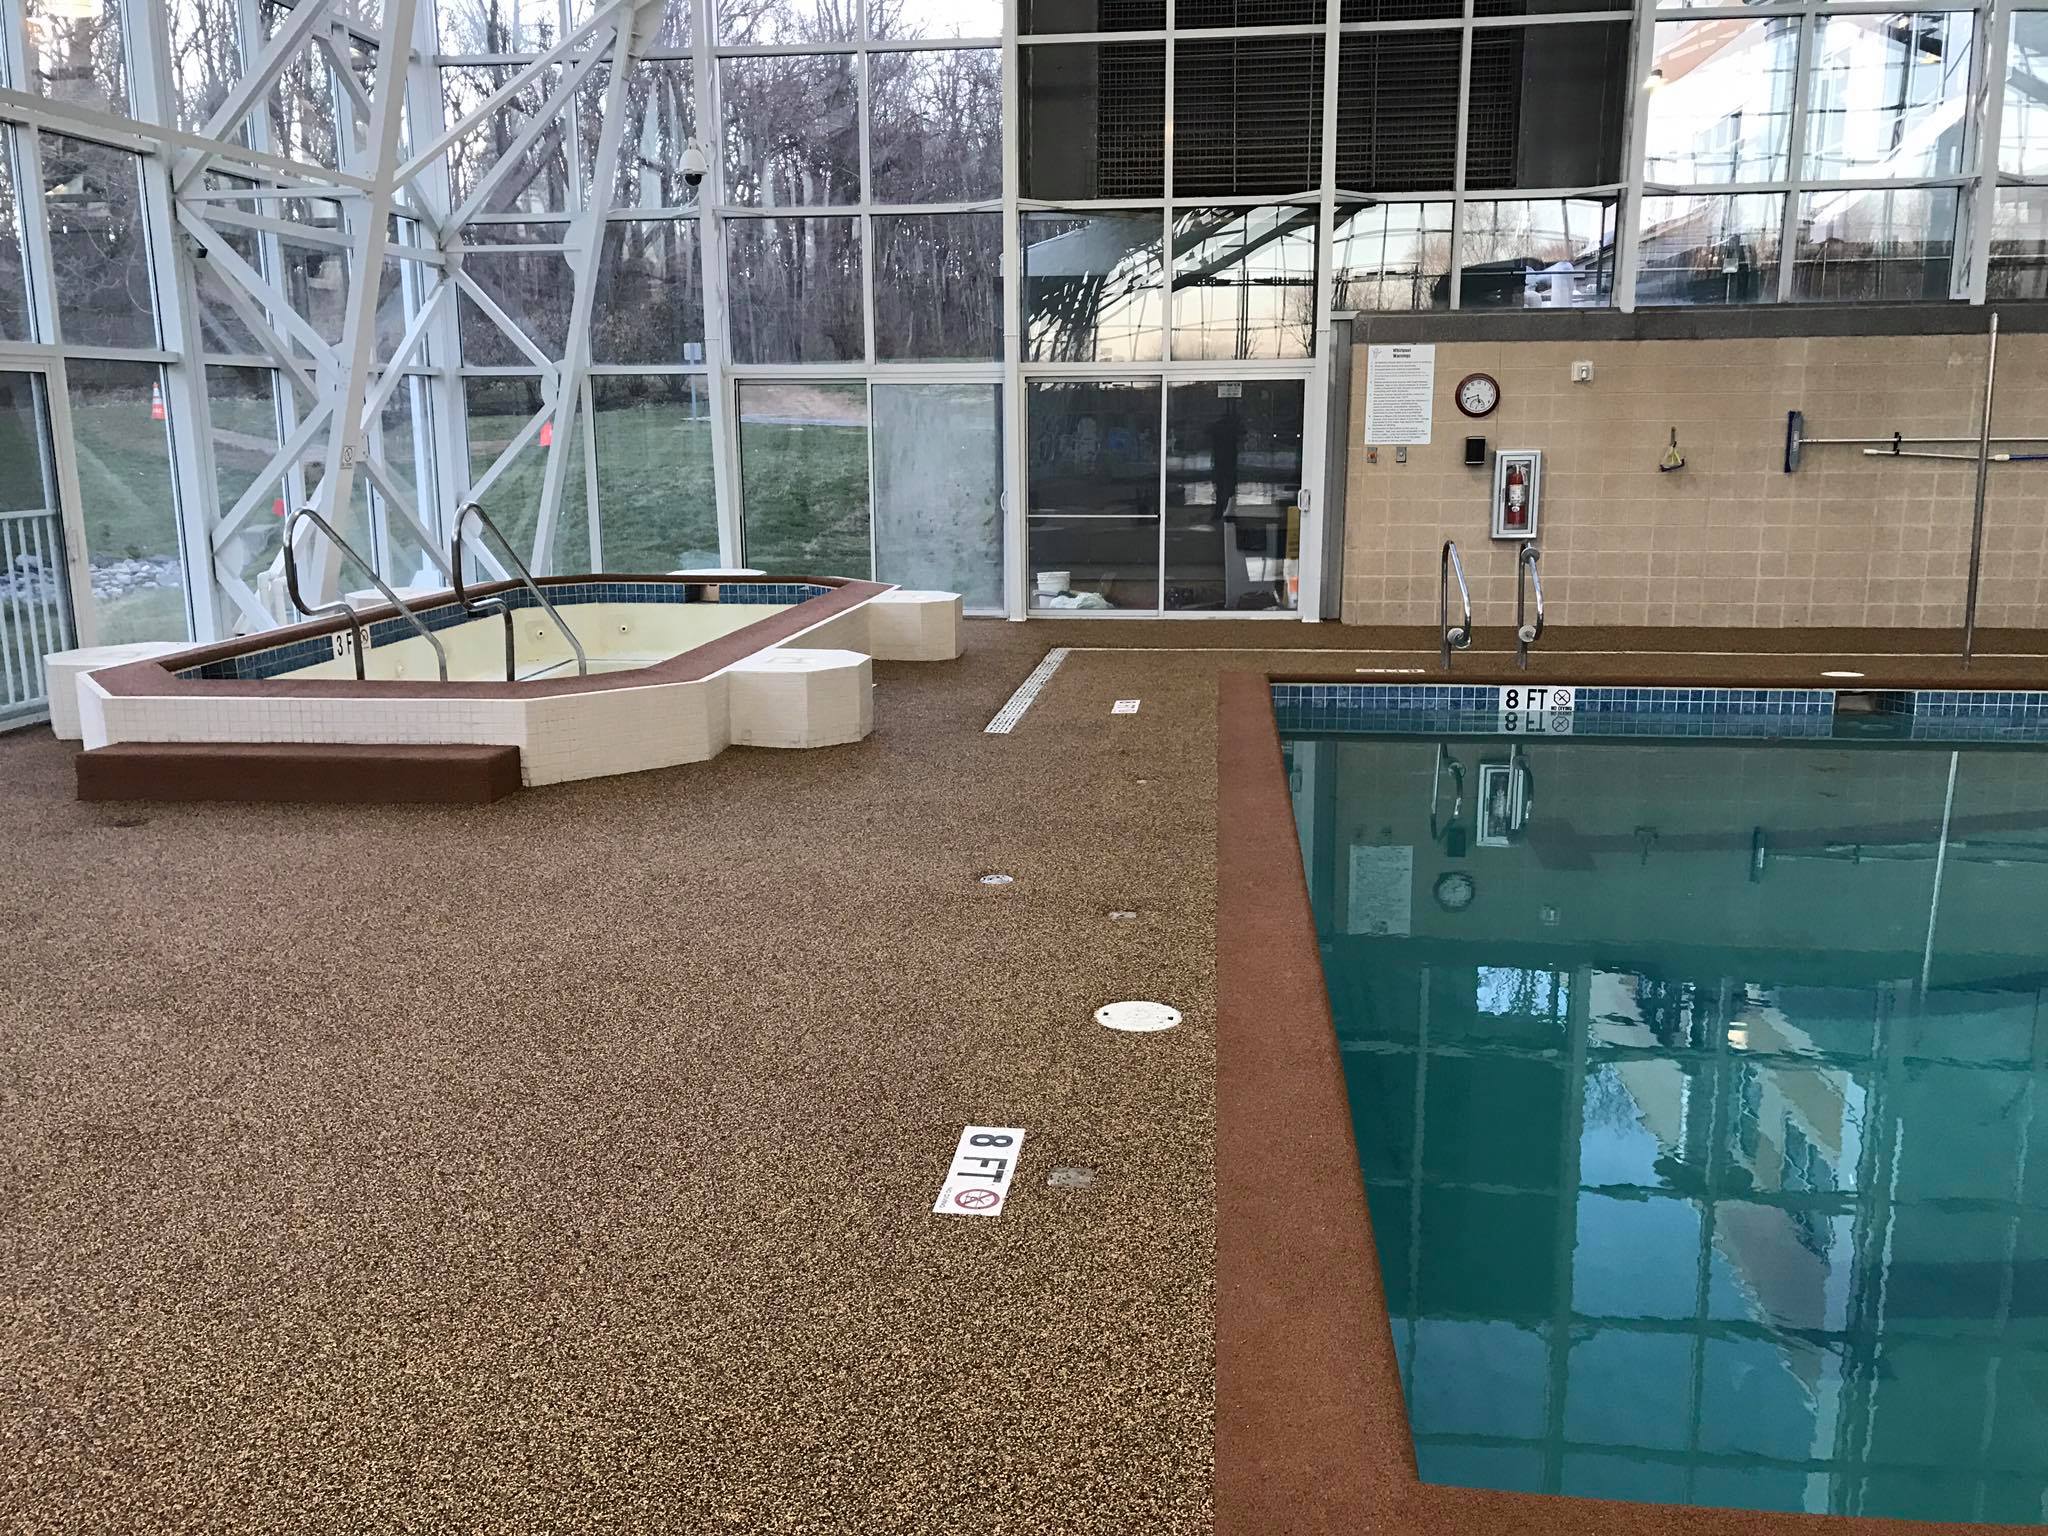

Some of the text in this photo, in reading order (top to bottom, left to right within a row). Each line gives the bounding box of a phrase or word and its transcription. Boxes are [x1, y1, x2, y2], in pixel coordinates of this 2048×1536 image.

[336, 632, 353, 656] 3 F
[1506, 689, 1548, 710] 8 FT
[957, 1134, 1013, 1183] 8 FT
